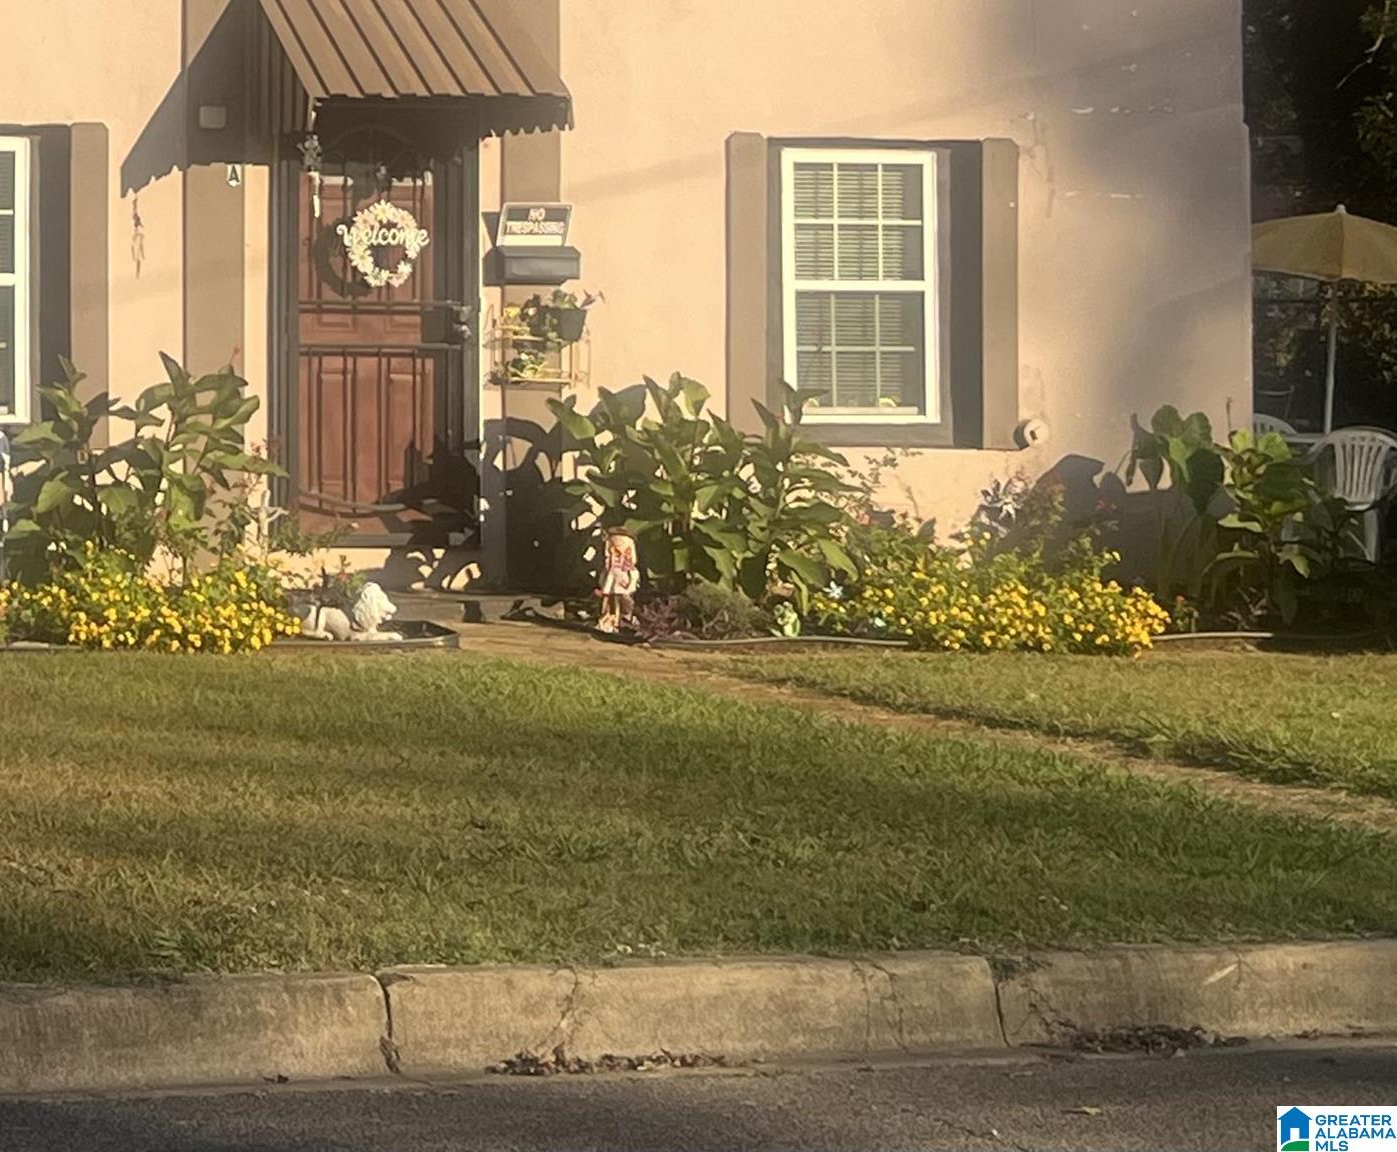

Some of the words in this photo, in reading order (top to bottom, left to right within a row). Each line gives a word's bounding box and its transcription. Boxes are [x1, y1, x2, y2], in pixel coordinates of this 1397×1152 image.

[228, 165, 240, 183] A
[528, 207, 546, 221] NO
[336, 224, 430, 247] Welcome
